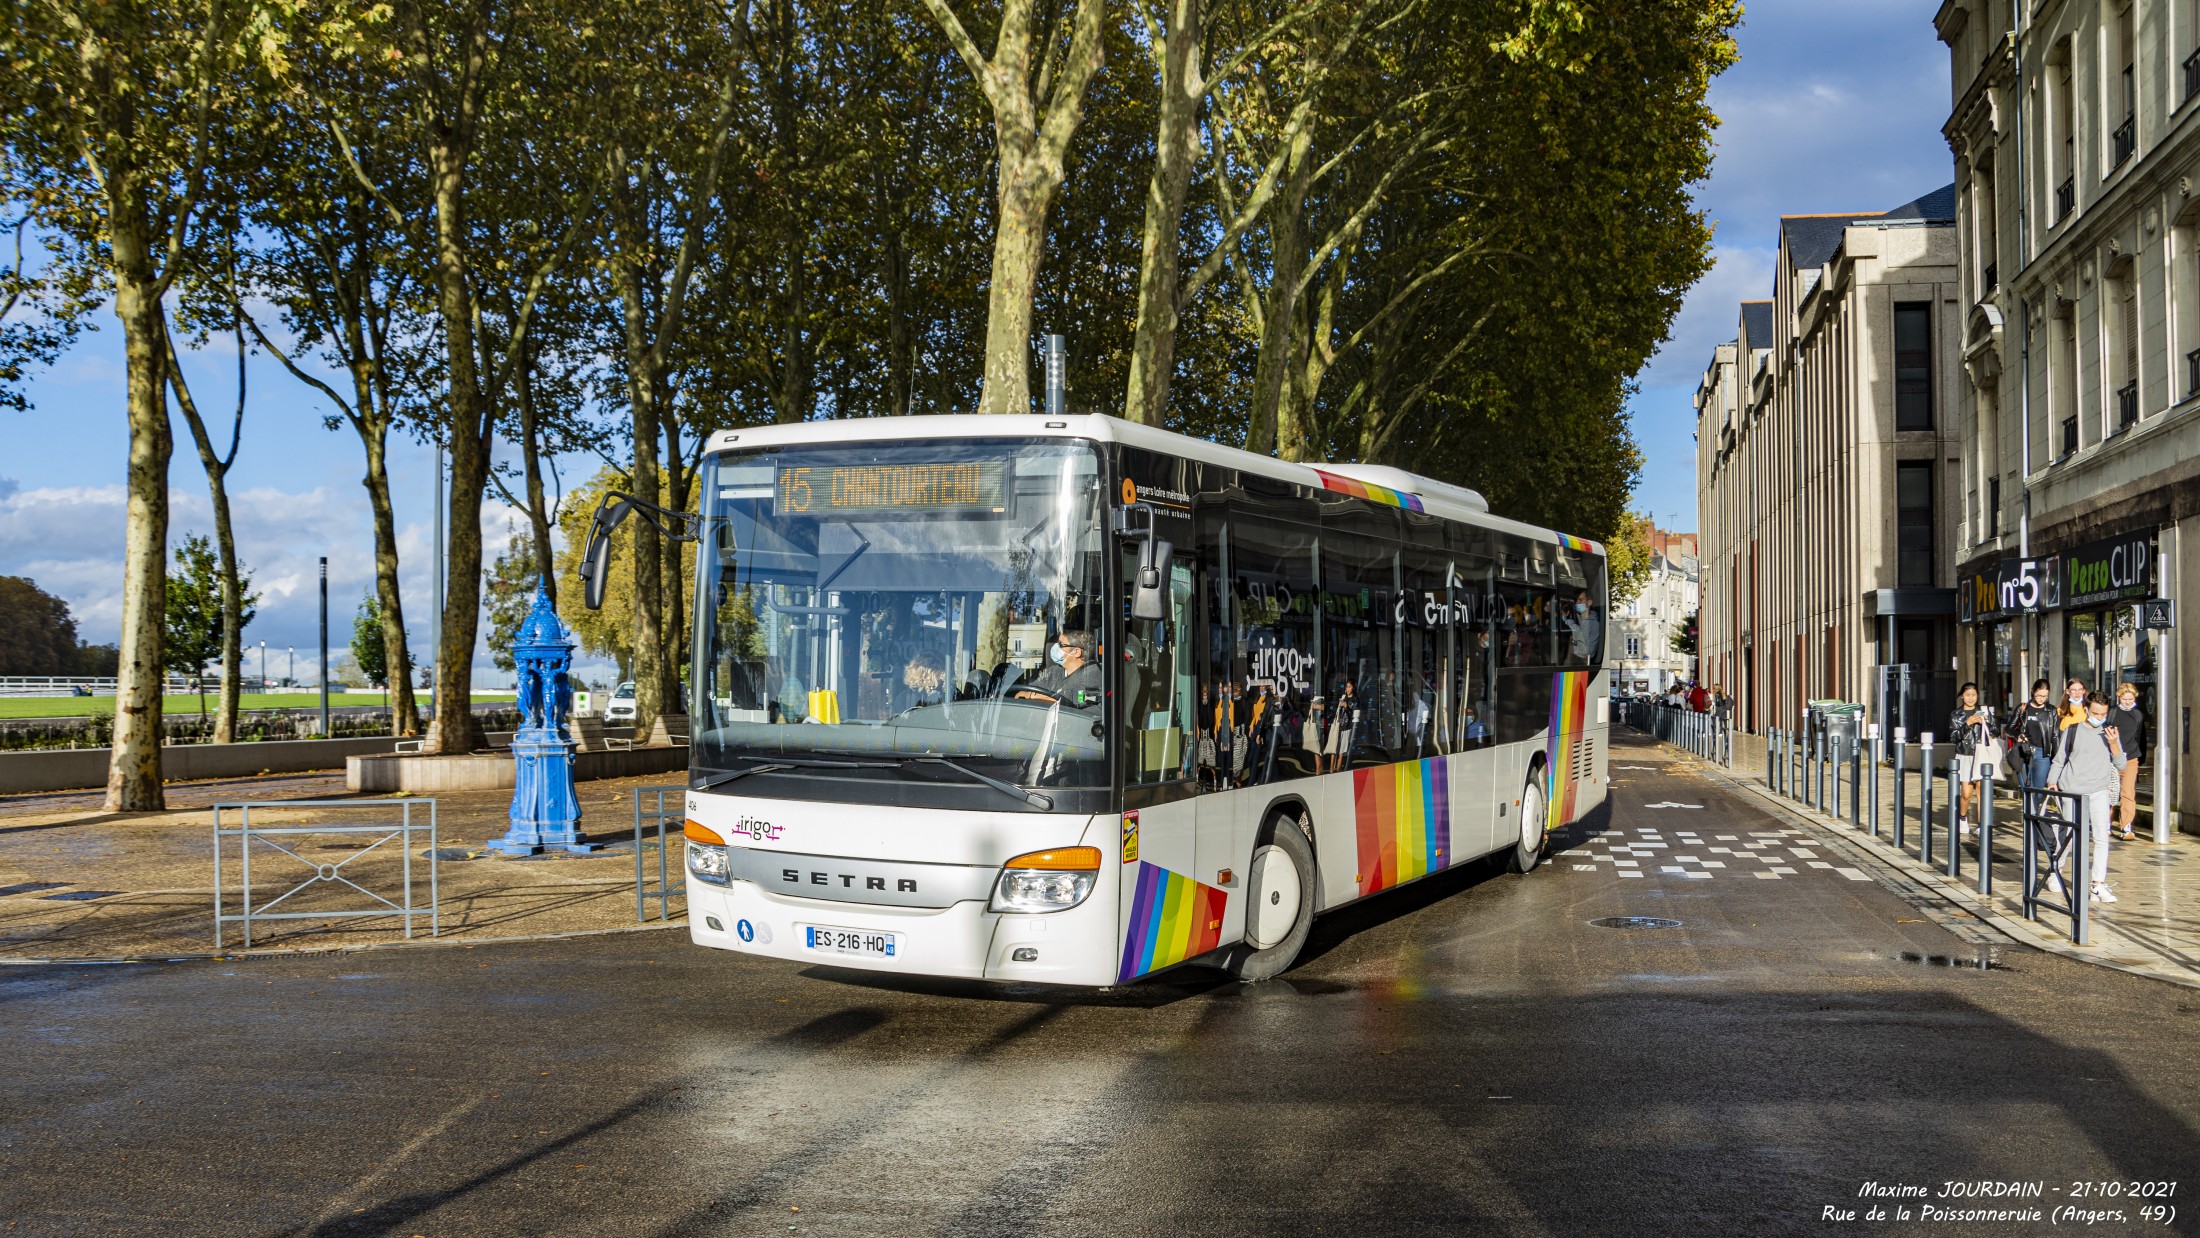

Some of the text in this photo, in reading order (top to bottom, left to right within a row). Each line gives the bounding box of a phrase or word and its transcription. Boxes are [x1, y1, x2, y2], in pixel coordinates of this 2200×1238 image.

[780, 465, 980, 512] 15 CHANTOURTEAU
[1136, 485, 1190, 503] angers loire métropole
[1171, 510, 1191, 519] urbaine
[2071, 541, 2146, 596] Perso CLIP
[1976, 575, 1996, 613] Pro
[1259, 637, 1299, 697] irigo
[783, 869, 917, 892] SETRA
